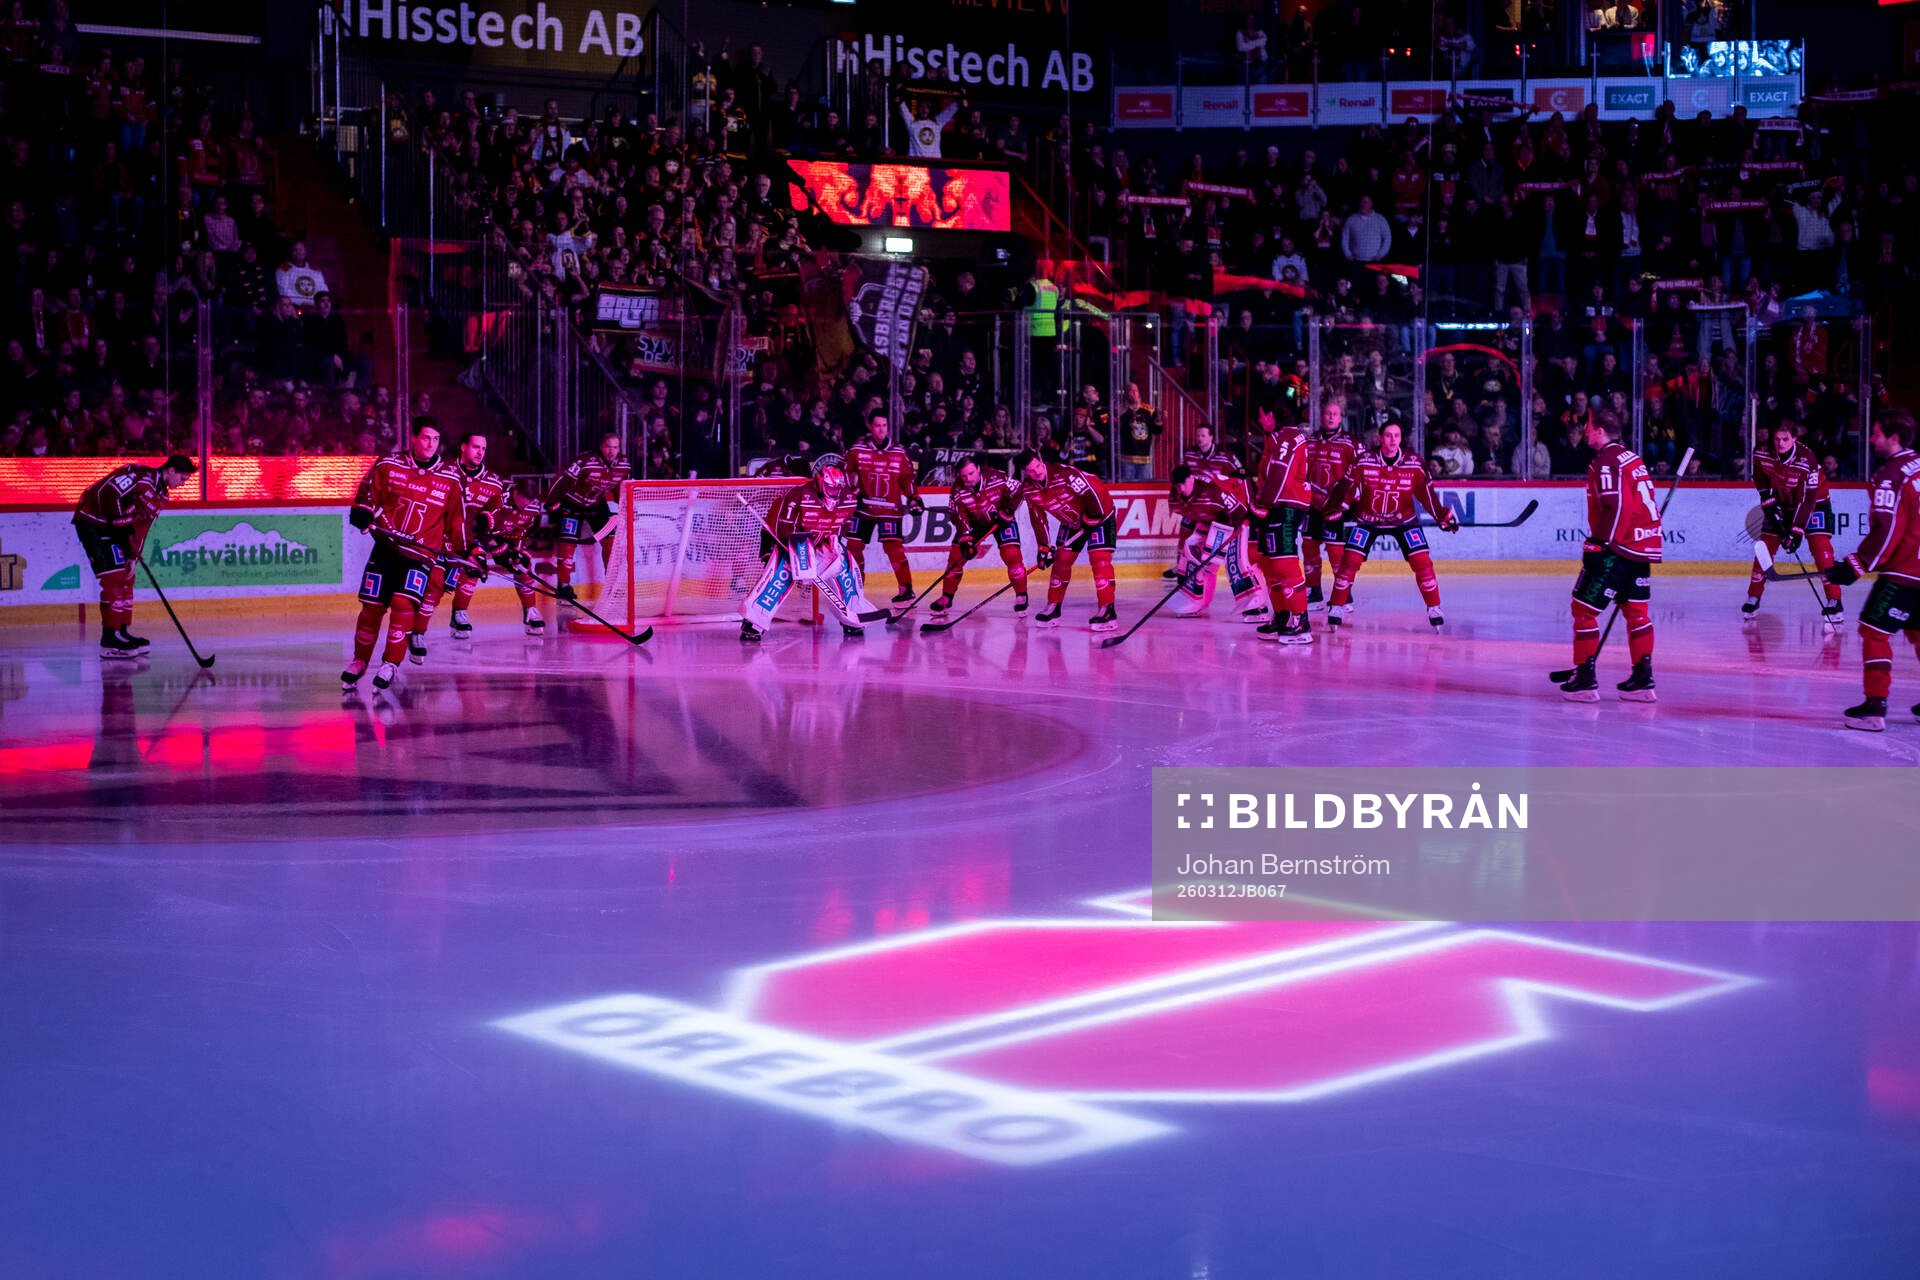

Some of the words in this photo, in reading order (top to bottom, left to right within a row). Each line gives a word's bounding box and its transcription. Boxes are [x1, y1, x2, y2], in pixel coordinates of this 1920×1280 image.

[359, 0, 563, 51] Hisstech
[578, 9, 644, 57] AB
[865, 33, 1029, 87] Hisstech
[1041, 50, 1095, 92] AB
[1610, 93, 1649, 104] EXACT
[1749, 91, 1788, 103] EXACT
[1874, 489, 1895, 507] 80
[150, 539, 318, 575] Ångtvättbilen
[761, 562, 792, 606] HEROK
